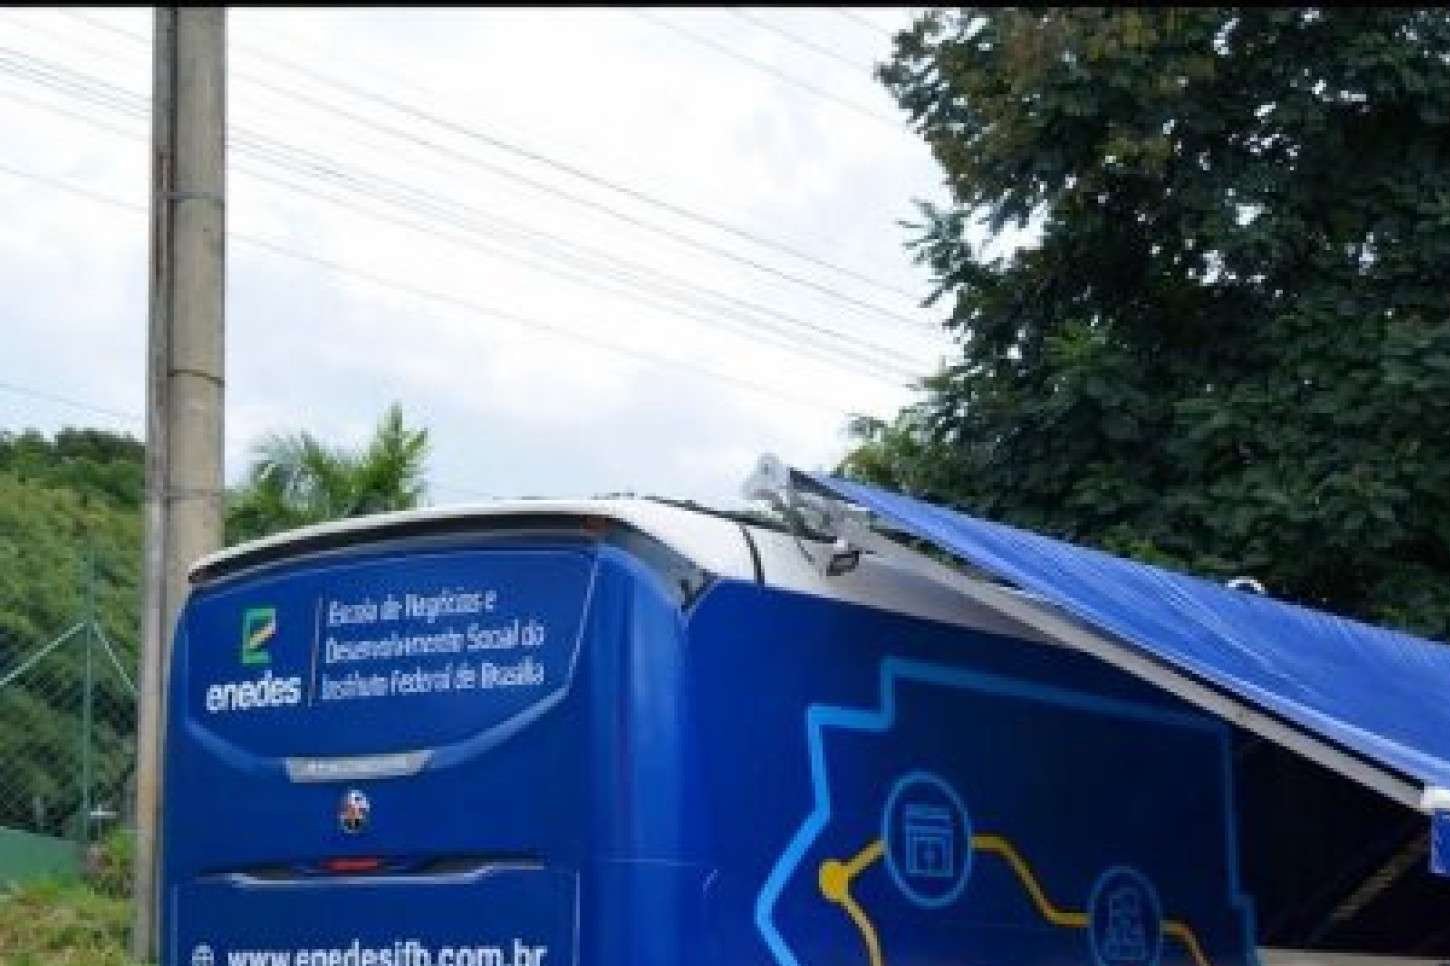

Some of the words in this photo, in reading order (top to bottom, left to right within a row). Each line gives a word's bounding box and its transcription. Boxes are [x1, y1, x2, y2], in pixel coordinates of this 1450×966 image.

[467, 620, 520, 651] Social
[522, 619, 545, 646] do
[206, 670, 302, 712] enedes
[390, 663, 450, 697] Federal
